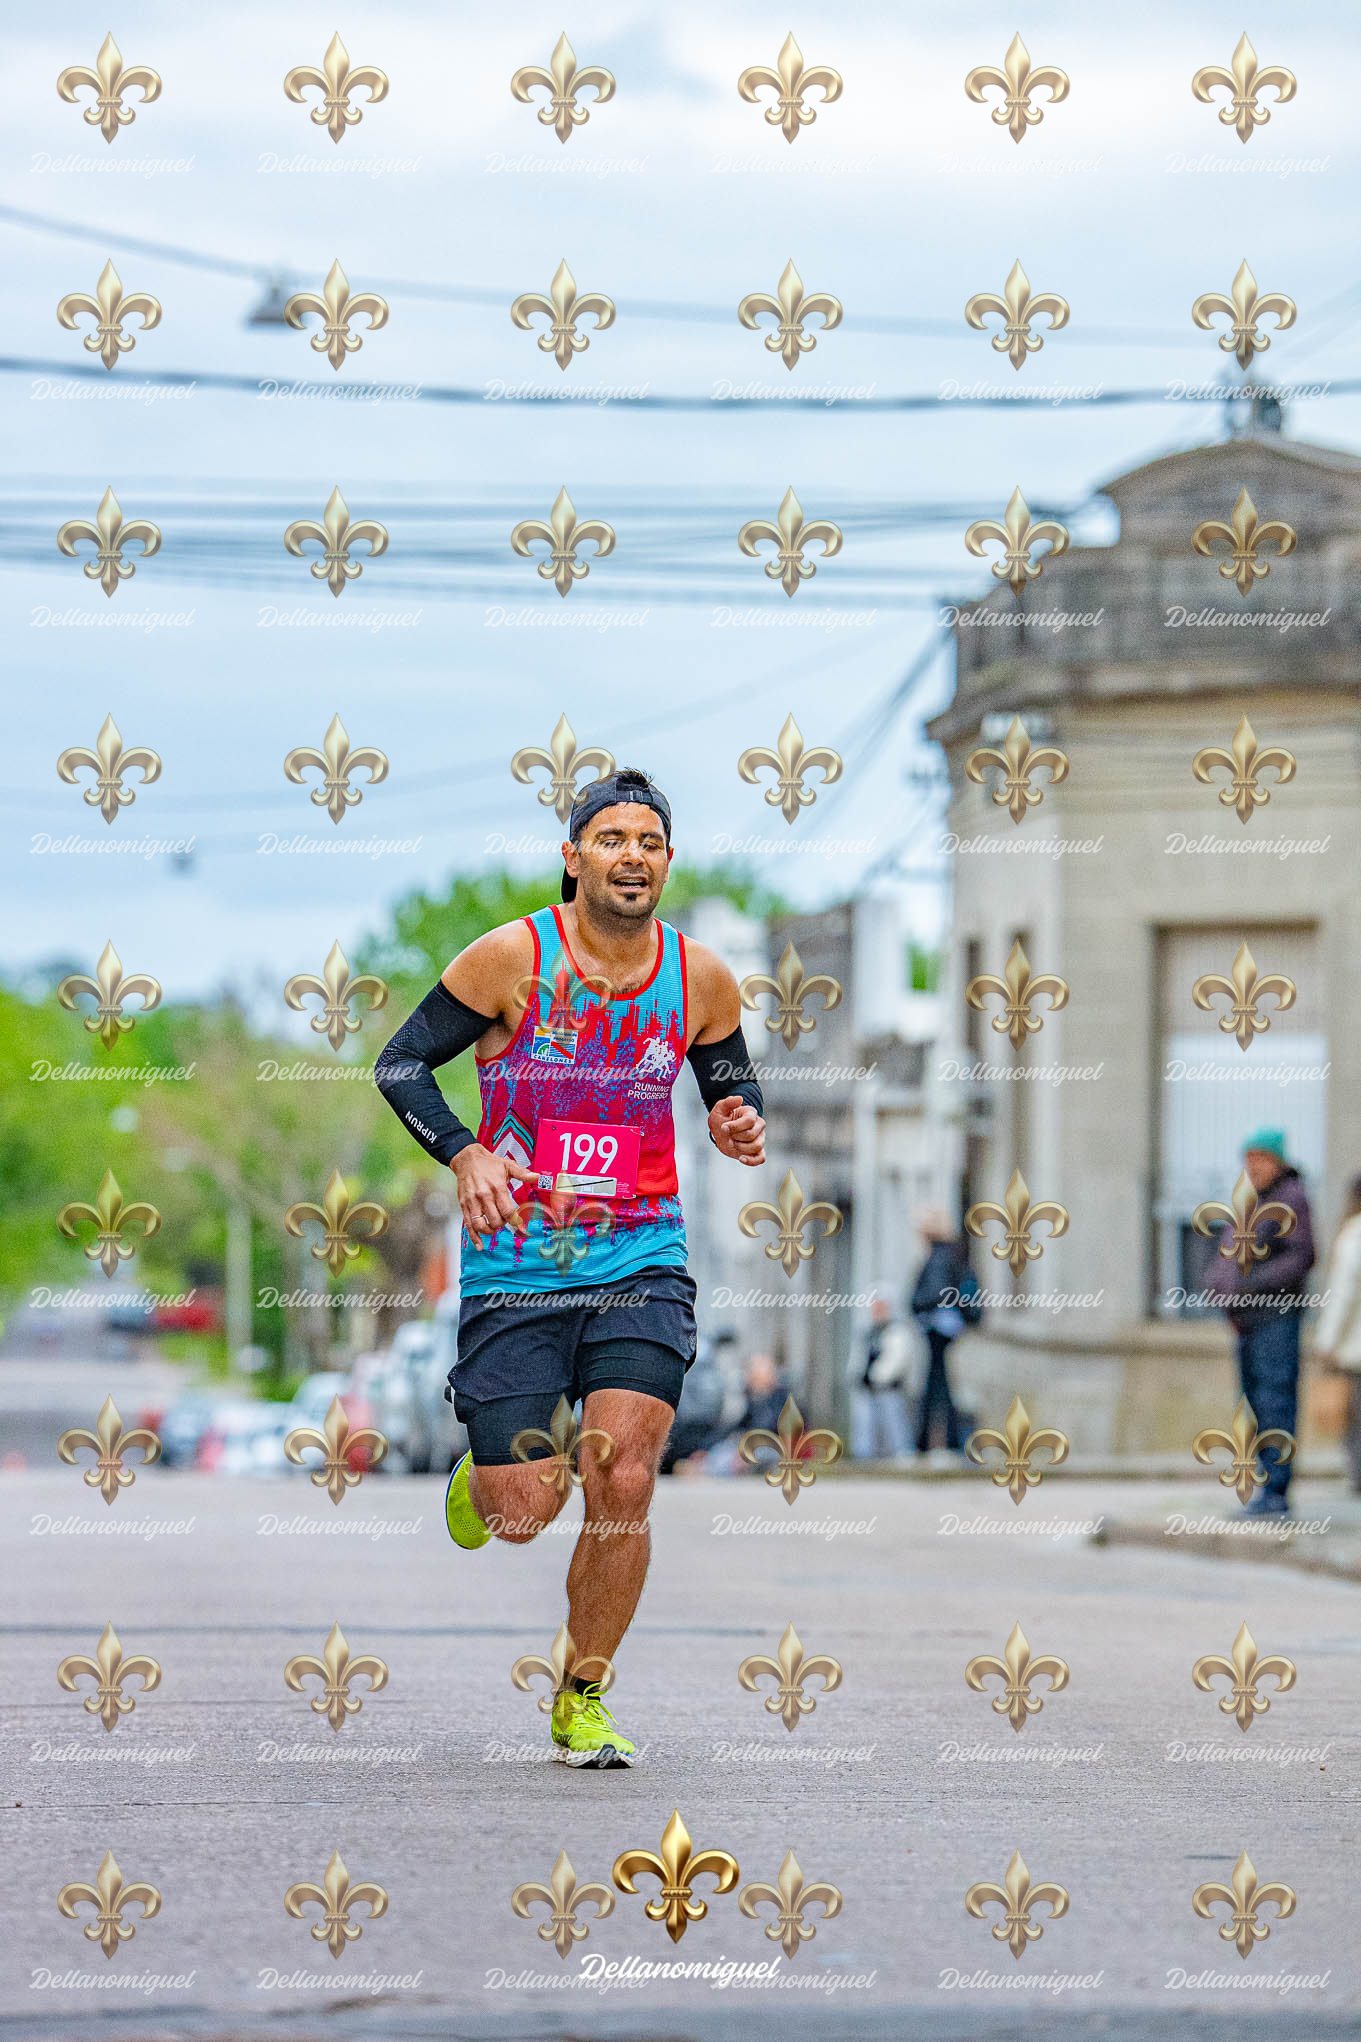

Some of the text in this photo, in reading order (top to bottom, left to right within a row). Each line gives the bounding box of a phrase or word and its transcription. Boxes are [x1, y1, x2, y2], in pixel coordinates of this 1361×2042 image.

[628, 1089, 668, 1100] PROGRESO
[634, 1082, 670, 1092] RUNNING
[405, 1110, 437, 1144] KIPRUN
[559, 1132, 619, 1174] 199
